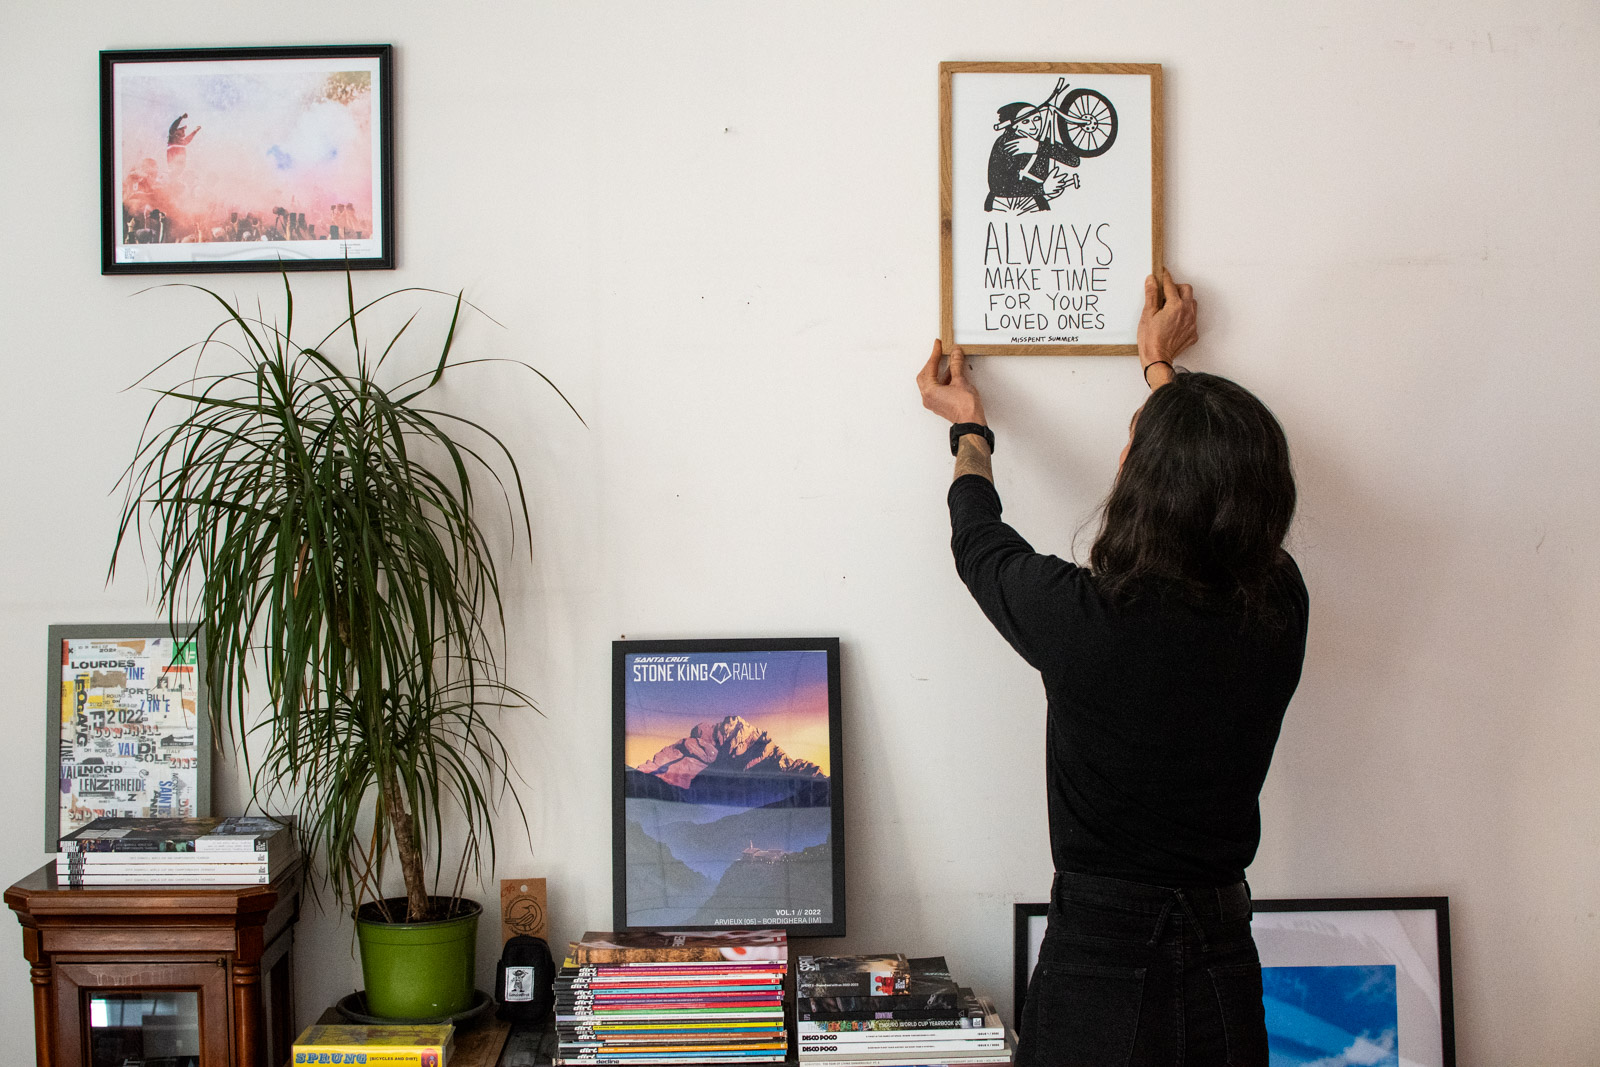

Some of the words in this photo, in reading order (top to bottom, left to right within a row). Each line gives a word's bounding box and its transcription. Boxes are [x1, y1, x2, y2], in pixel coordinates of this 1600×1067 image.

[984, 221, 1113, 266] ALWAYS
[984, 266, 1041, 291] MAKE
[1051, 267, 1110, 292] TIME
[989, 293, 1031, 311] FOR
[1046, 292, 1099, 312] YOUR
[985, 313, 1049, 331] LOVED
[1057, 313, 1105, 330] ONES
[71, 660, 136, 670] LOURDES
[633, 664, 675, 682] STONE
[732, 662, 768, 680] RALLY
[762, 917, 808, 925] BORDIGHERA
[295, 1052, 367, 1064] SPRUNG
